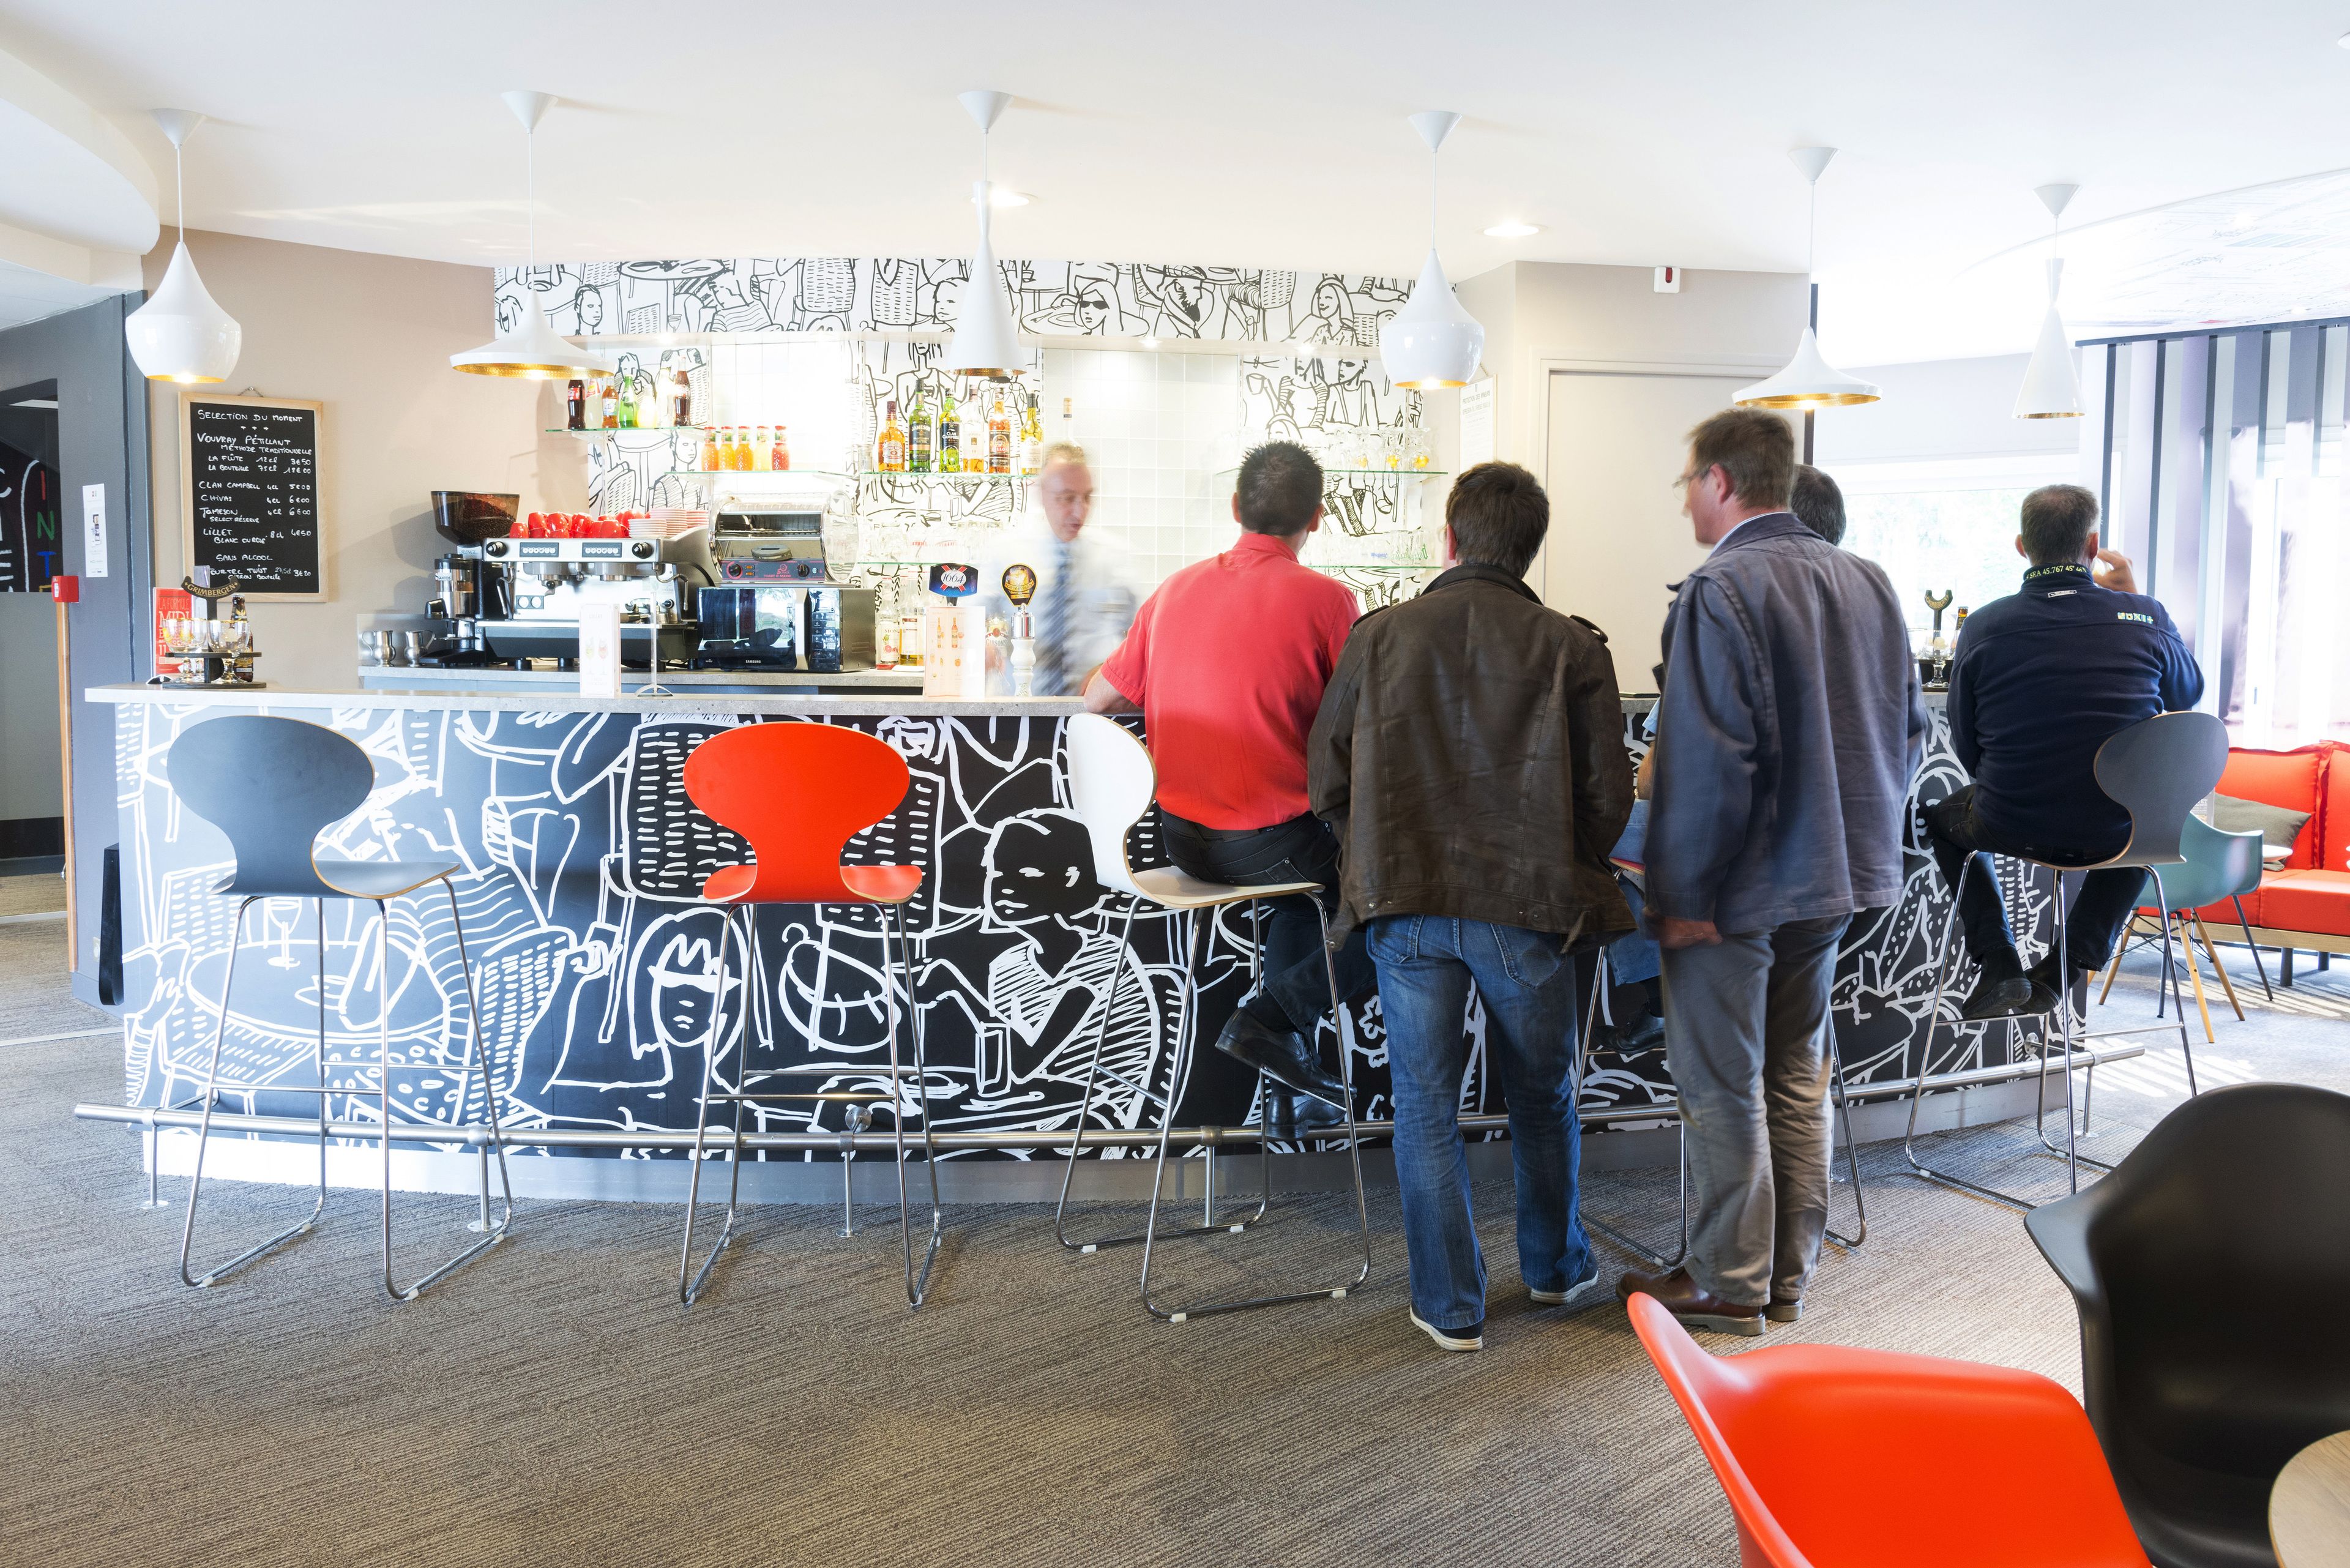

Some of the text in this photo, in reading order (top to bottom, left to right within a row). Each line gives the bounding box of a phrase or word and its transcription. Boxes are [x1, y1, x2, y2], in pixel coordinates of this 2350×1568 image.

[198, 409, 248, 420] SELECTION
[197, 433, 237, 445] VOUVRAY
[221, 444, 312, 455] MÉTHODE TRADITIONNELLE
[198, 480, 222, 489] CLAN
[203, 528, 233, 536] LILLET
[2029, 570, 2041, 578] SEA
[2042, 566, 2064, 575] 45.767
[942, 572, 964, 584] 1664
[187, 582, 235, 596] GRIMBERGEN
